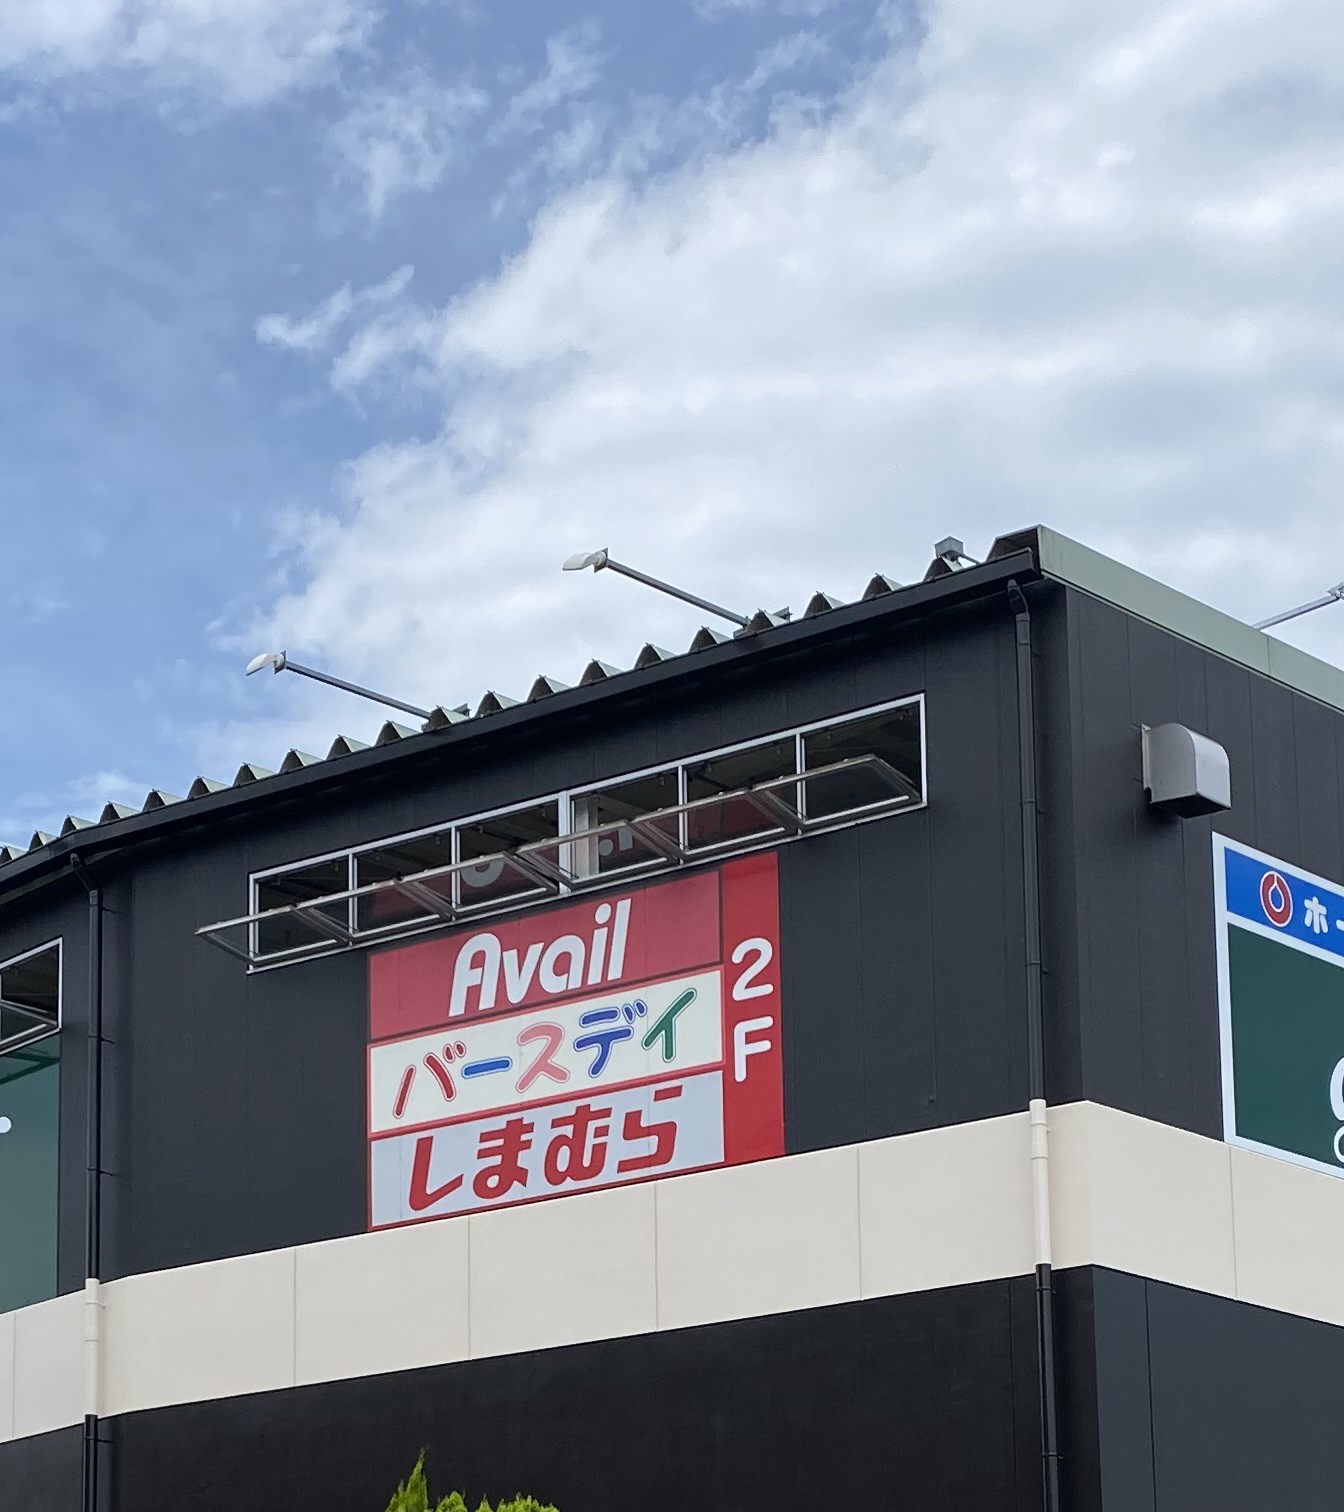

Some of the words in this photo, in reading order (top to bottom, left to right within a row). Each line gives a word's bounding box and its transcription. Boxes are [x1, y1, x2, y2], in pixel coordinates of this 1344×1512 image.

[448, 898, 632, 1018] Avail
[731, 937, 774, 1083] 2F
[392, 987, 697, 1119] バースデイ
[408, 1085, 684, 1212] しまむら
